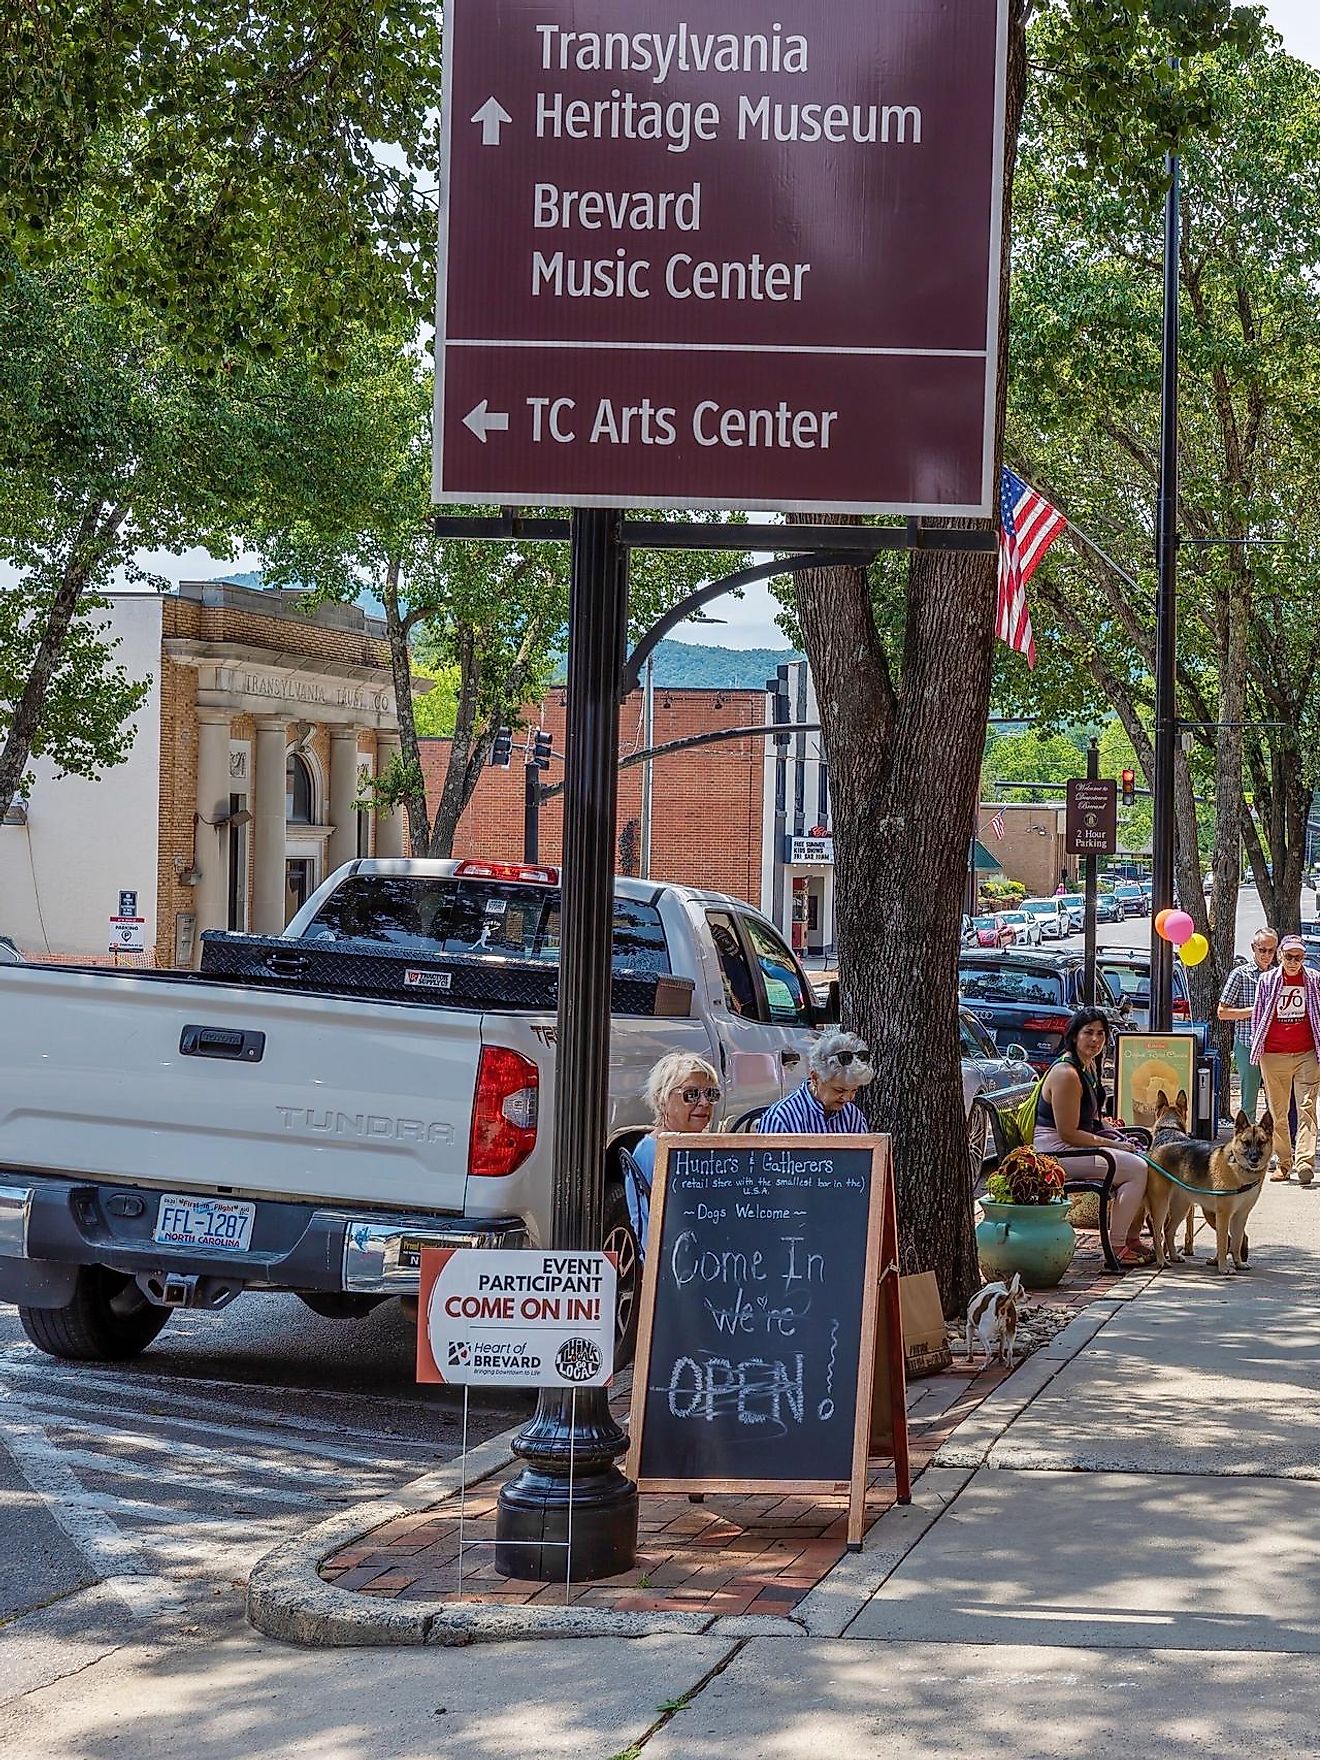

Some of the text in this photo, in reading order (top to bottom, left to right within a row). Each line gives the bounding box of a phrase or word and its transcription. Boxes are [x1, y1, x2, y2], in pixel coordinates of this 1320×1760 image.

[536, 22, 809, 83] Transylvania
[535, 89, 923, 153] Heritage Museum
[534, 183, 701, 232] Brevard
[531, 248, 810, 301] Music Center
[526, 396, 838, 449] TC Arts Center
[246, 674, 326, 702] TRANSYLVANIA
[1075, 839, 1107, 849] Parking
[1076, 829, 1107, 839] 2 Hour
[275, 1105, 456, 1146] TUNDRA
[763, 1151, 834, 1175] Gatherers
[735, 1177, 754, 1187] with
[757, 1177, 772, 1187] the
[775, 1177, 812, 1188] smallest
[817, 1178, 832, 1188] bar
[833, 1179, 843, 1189] in
[161, 1207, 249, 1239] FFL-1287
[165, 1232, 241, 1248] NORTH CAROLINA
[543, 1258, 604, 1275] EVENT
[671, 1229, 826, 1291] Come In
[478, 1275, 604, 1293] PARTICIPANT
[445, 1296, 601, 1321] COME ON IN!
[704, 1288, 797, 1337] We're
[474, 1342, 527, 1356] Heart of
[474, 1355, 541, 1368] BREVARD
[560, 1362, 596, 1380] LOCAL
